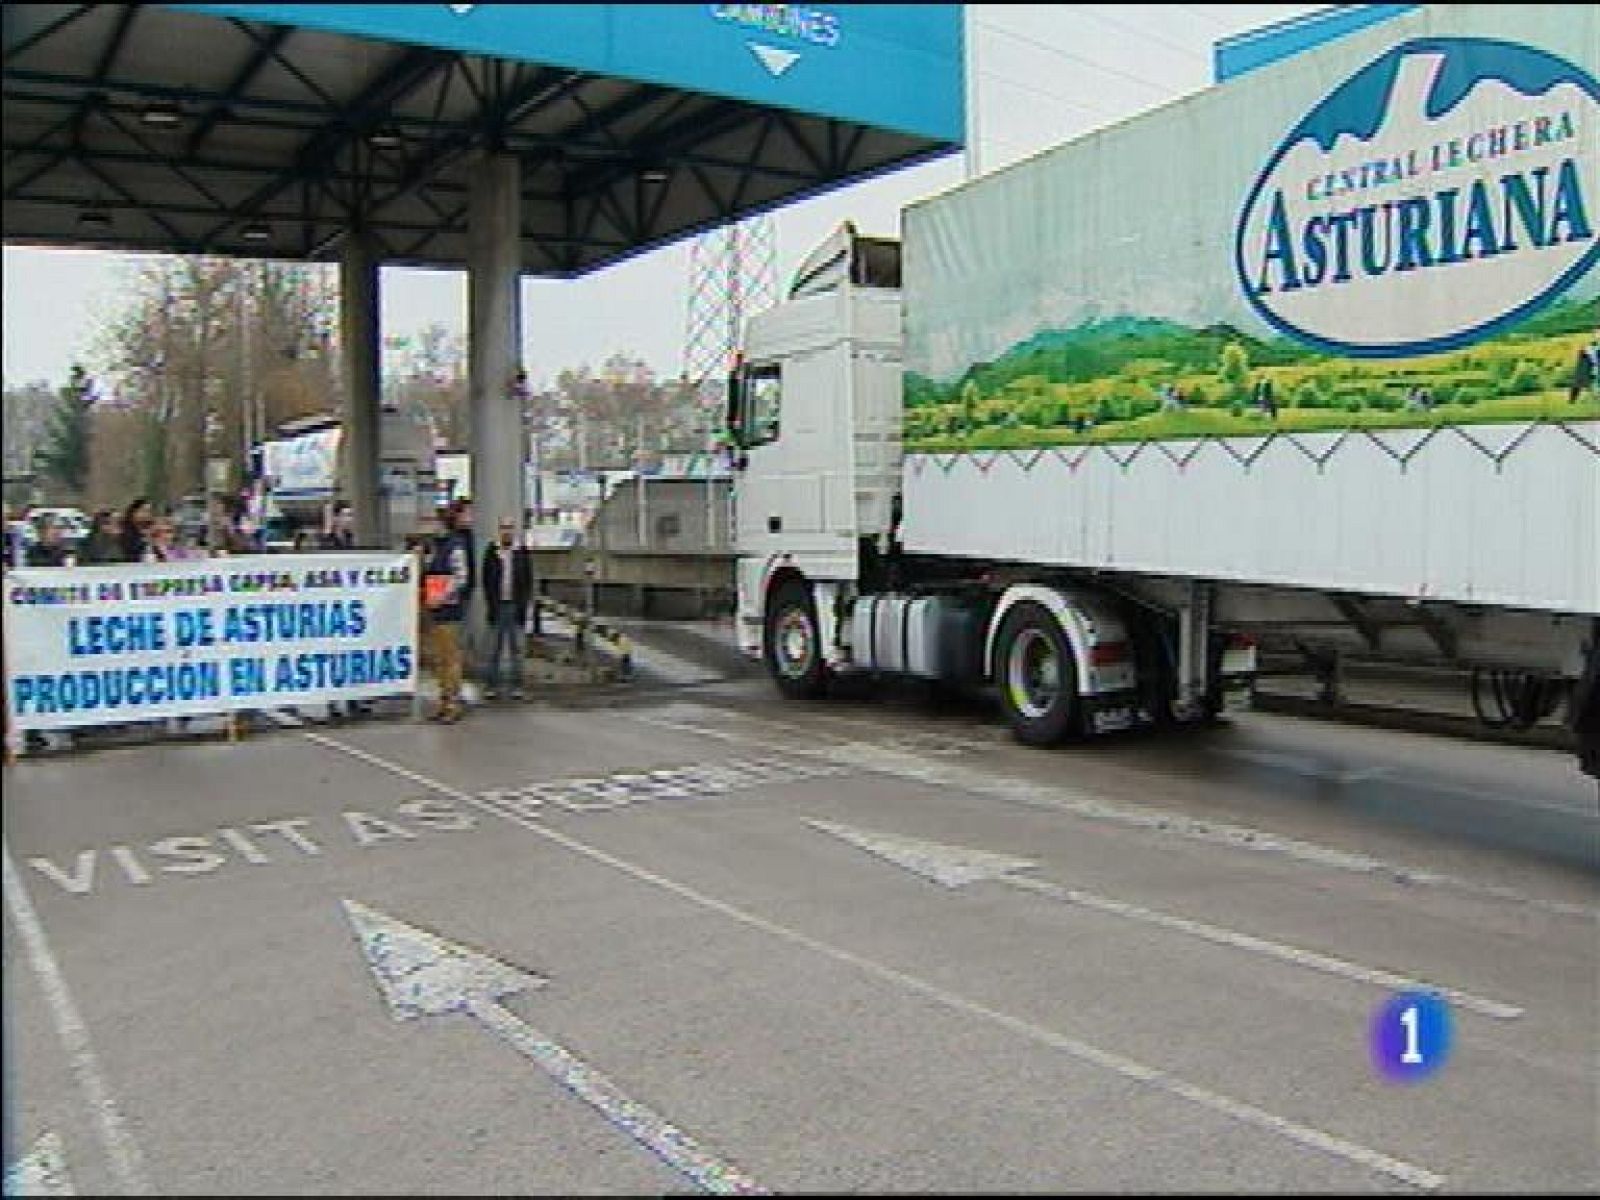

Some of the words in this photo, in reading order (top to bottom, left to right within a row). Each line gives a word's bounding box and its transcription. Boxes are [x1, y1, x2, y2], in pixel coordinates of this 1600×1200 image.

[1306, 150, 1419, 201] CENTRAL
[1431, 111, 1574, 172] LECHERA
[1252, 158, 1592, 293] ASTURIANA
[67, 614, 165, 655] LECHE
[174, 607, 215, 646] DE
[224, 599, 367, 642] ASTURIAS
[230, 657, 267, 696] EN
[273, 645, 412, 692] ASTURIAS
